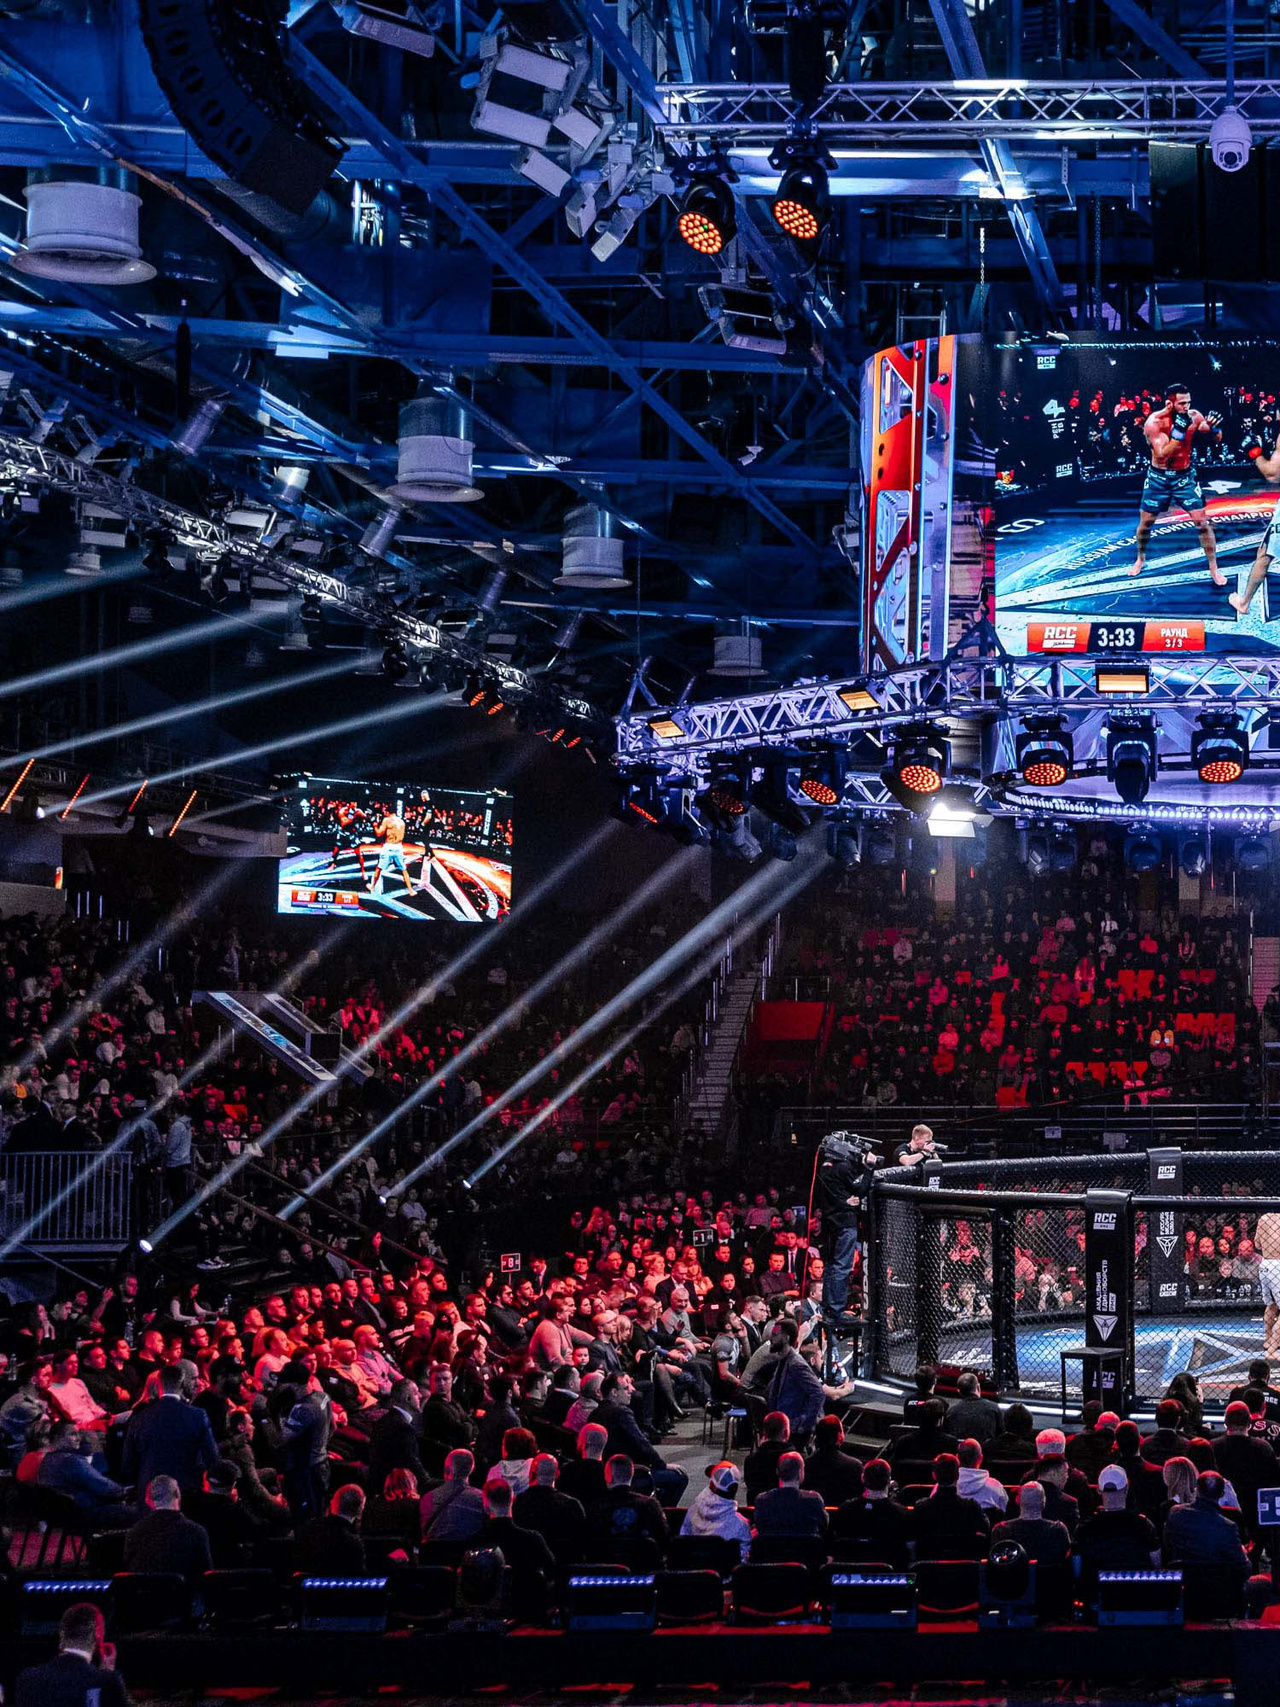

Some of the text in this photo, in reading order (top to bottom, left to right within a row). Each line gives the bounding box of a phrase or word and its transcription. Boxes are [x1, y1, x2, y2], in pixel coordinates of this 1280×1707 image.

[1037, 356, 1056, 365] RCC
[1056, 463, 1073, 473] RCC
[1212, 511, 1275, 523] CHAMPIO
[1044, 626, 1077, 639] RCC
[1097, 628, 1136, 647] 3:33
[1160, 628, 1188, 638] РАУНД
[1165, 638, 1183, 648] 3/3
[317, 892, 334, 902] 3:33
[1159, 1165, 1176, 1173] RCC
[1094, 1213, 1117, 1223] RCC
[508, 1257, 514, 1268] 8
[1160, 1283, 1177, 1291] RCC
